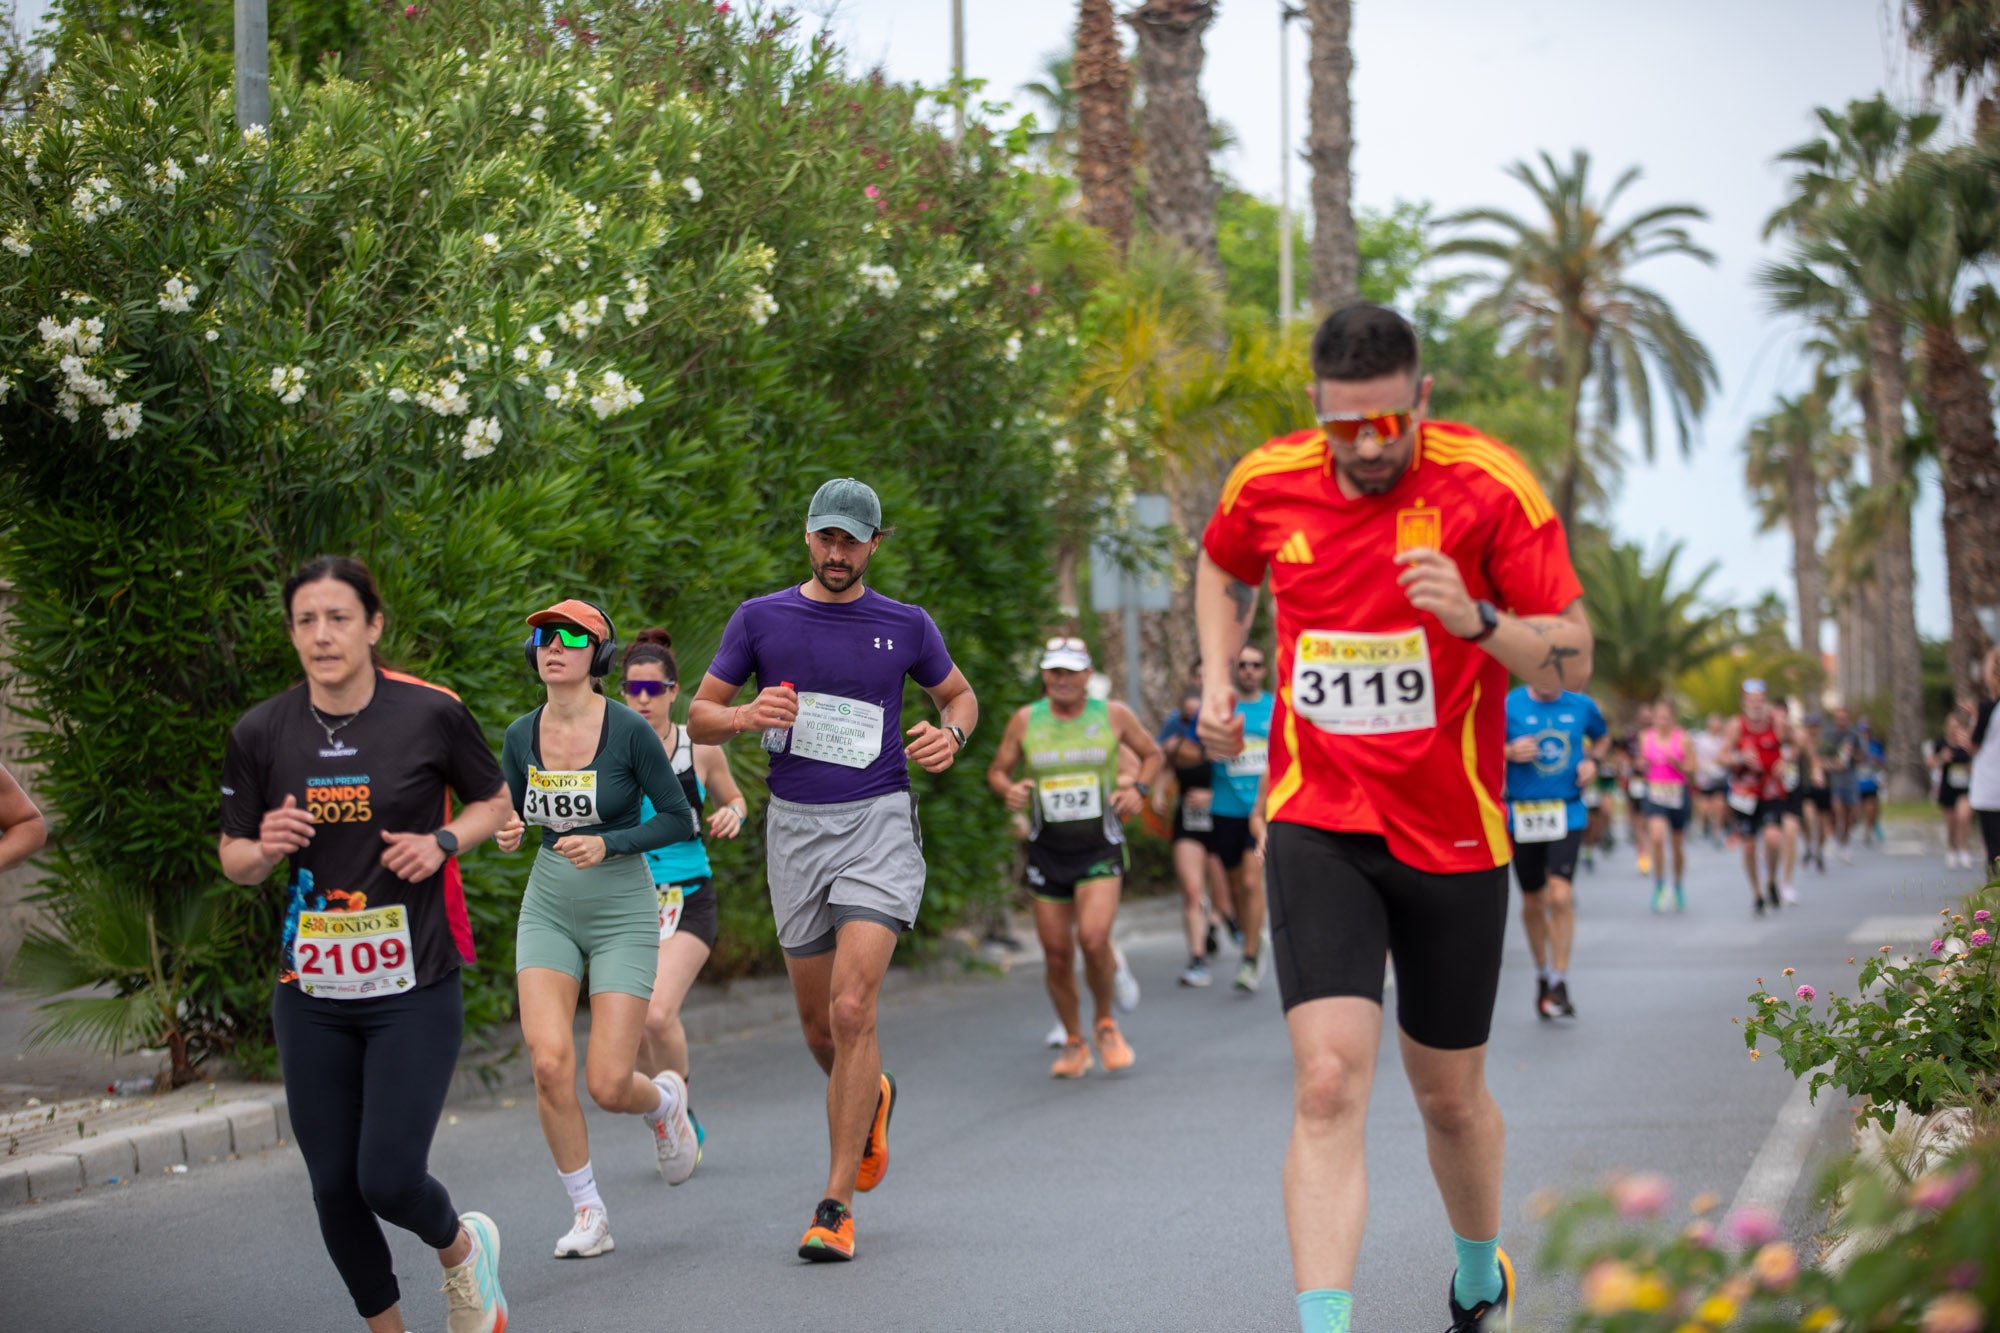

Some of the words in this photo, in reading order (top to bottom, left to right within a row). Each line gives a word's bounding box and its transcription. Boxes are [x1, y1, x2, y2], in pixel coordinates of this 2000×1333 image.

[1301, 669, 1425, 706] 3119
[840, 726, 865, 739] CONTRA
[307, 777, 333, 786] GRAN
[334, 774, 371, 785] PREMIO
[541, 779, 578, 788] ONDO
[306, 785, 371, 802] FONDO
[526, 789, 593, 818] 3189
[1051, 790, 1090, 810] 792
[307, 800, 372, 824] 2025
[298, 938, 406, 976] 2109
